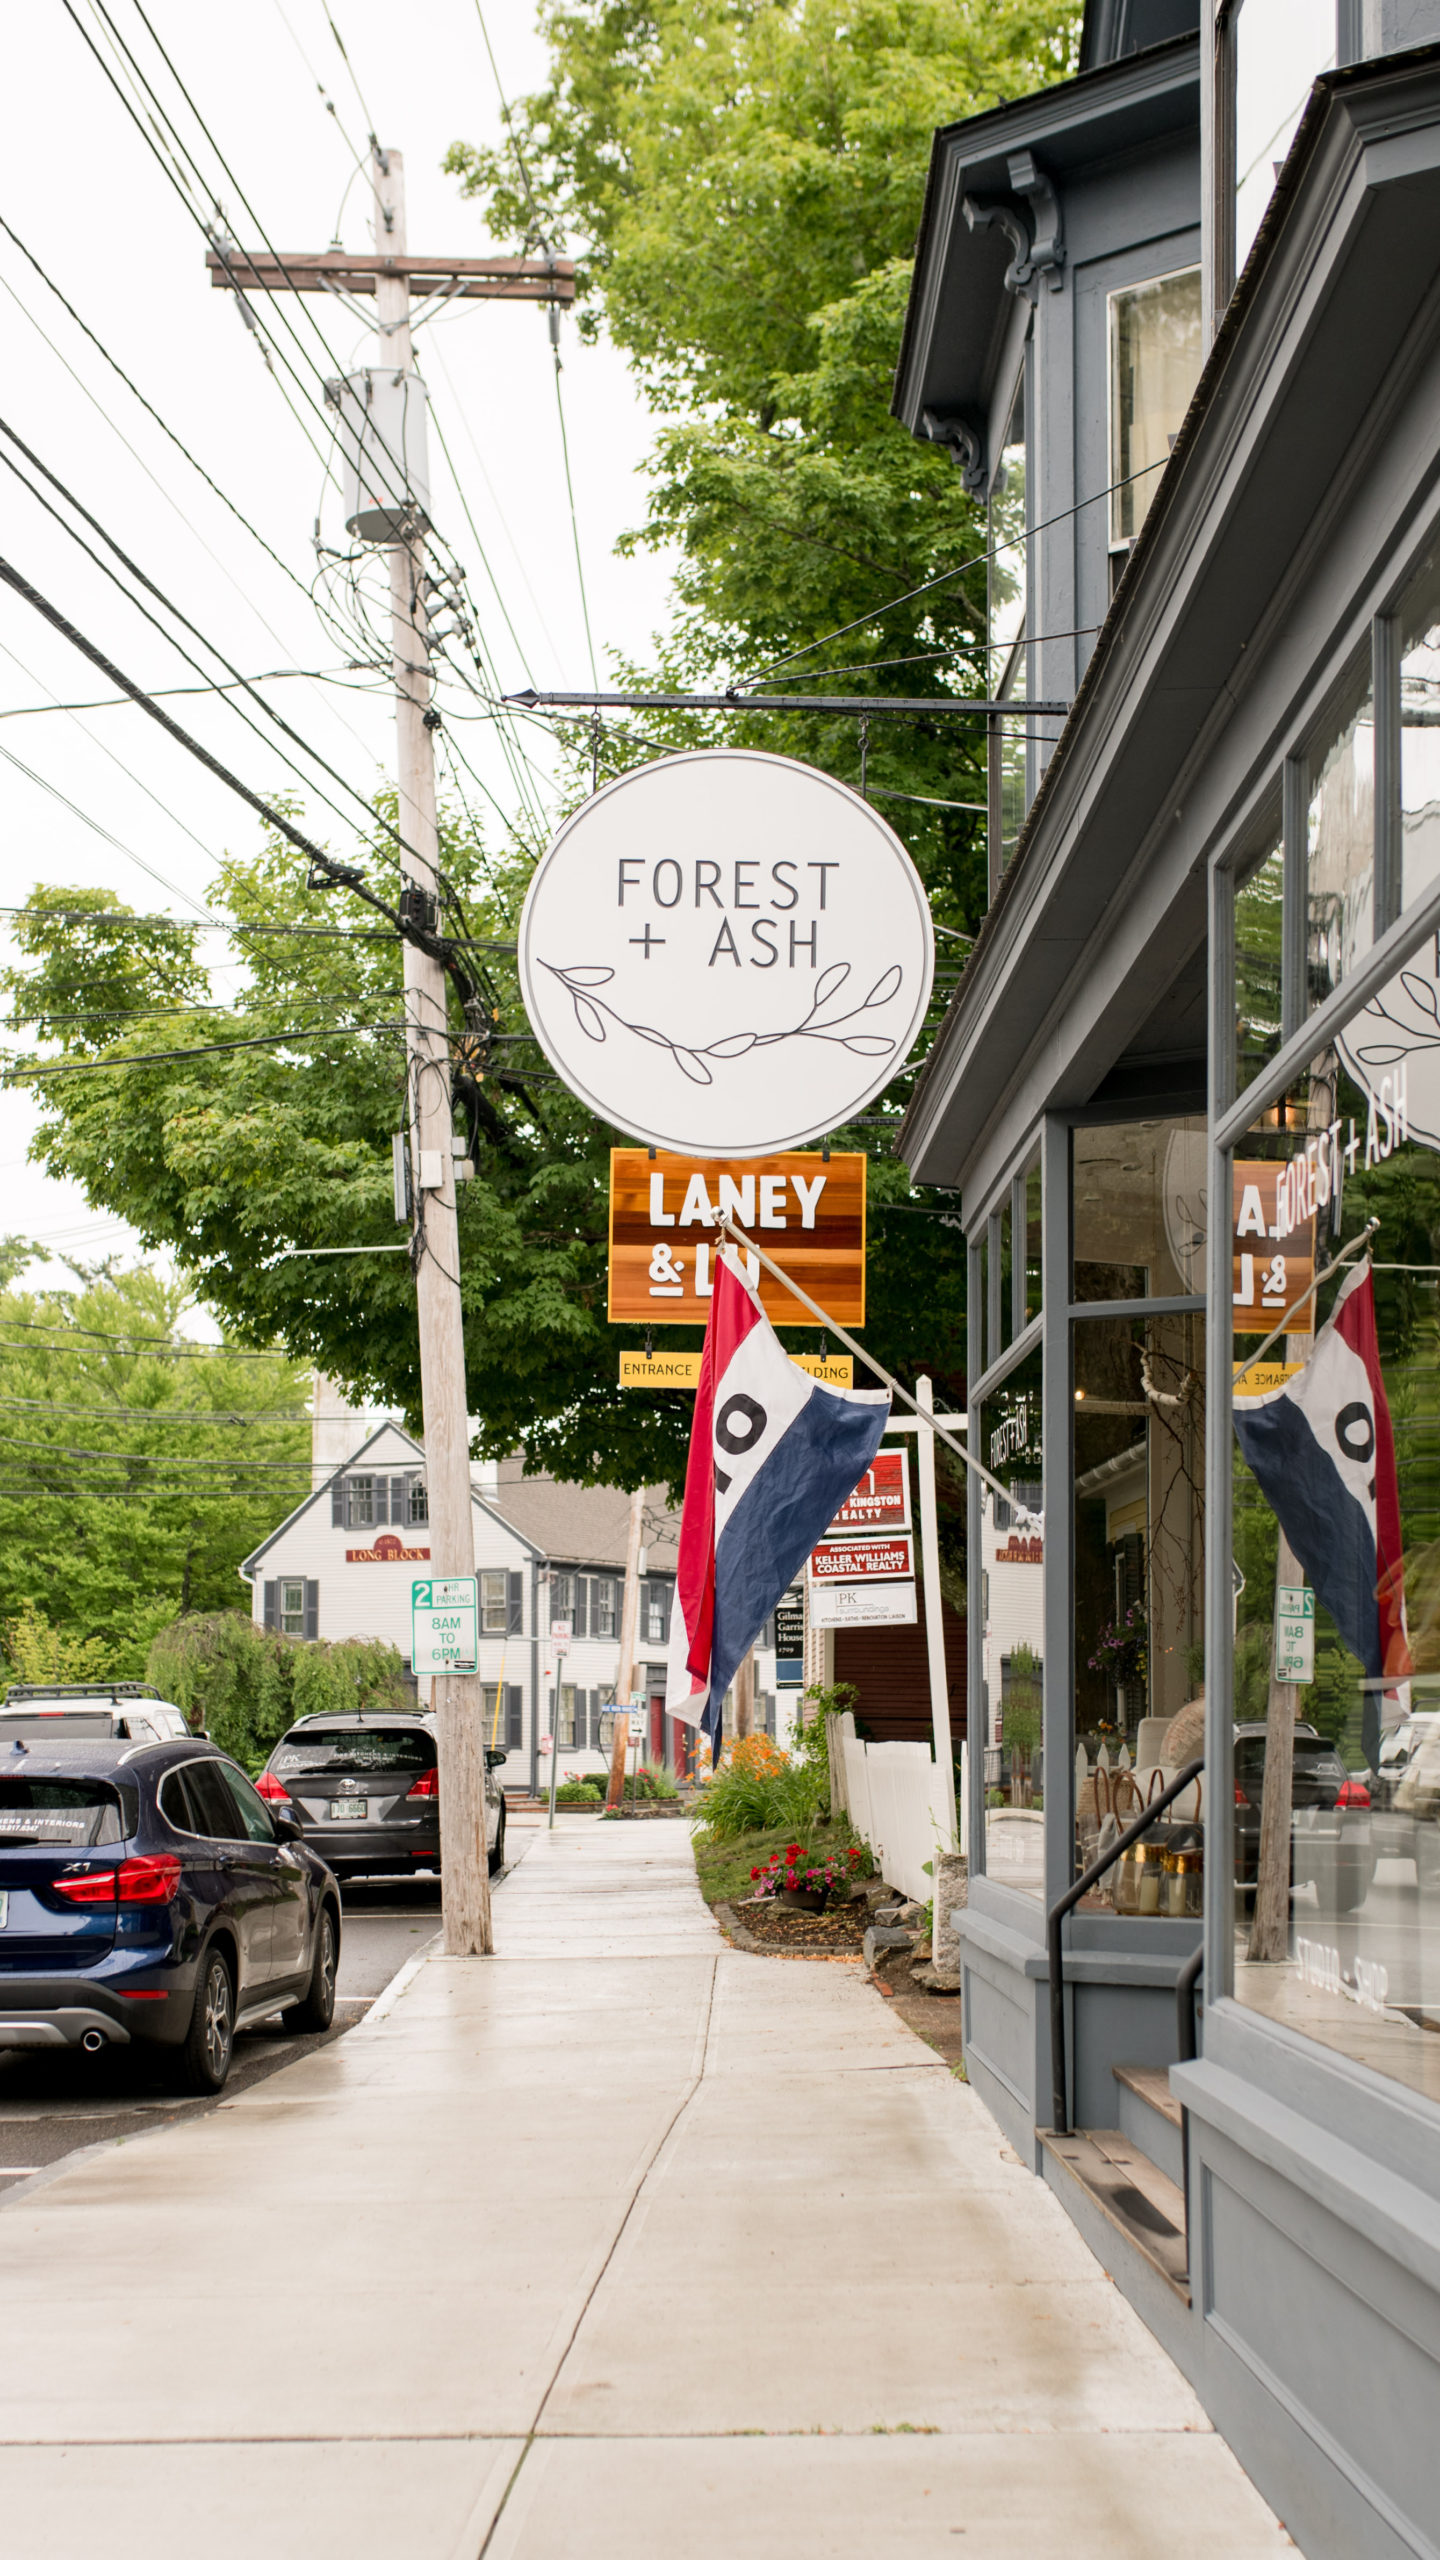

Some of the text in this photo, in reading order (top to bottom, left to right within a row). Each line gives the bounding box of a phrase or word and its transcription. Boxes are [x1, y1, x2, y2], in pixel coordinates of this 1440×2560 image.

[618, 858, 840, 911] FOREST
[629, 916, 818, 969] + ASH
[1276, 1119, 1342, 1242] FOREST
[1365, 1062, 1408, 1171] ASH
[650, 1173, 827, 1229] LANEY
[649, 1242, 685, 1284] &
[624, 1363, 693, 1377] ENTRANCE
[849, 1495, 901, 1508] KINGSTON
[352, 1548, 424, 1561] LONG BLOCK
[829, 1543, 890, 1553] ASSOCIATED WITH
[815, 1551, 905, 1565] KELLER WILLIAMS
[817, 1560, 904, 1574] COASTAL REALTY
[414, 1582, 460, 1607] 2 HR
[436, 1593, 471, 1605] PARKING
[839, 1592, 857, 1604] PK
[431, 1616, 461, 1630] 8AM
[777, 1611, 803, 1621] Gilma
[438, 1632, 456, 1644] TO
[431, 1647, 461, 1661] 6PM
[34, 1818, 85, 1829] INTERIORS
[62, 1861, 91, 1873] X1
